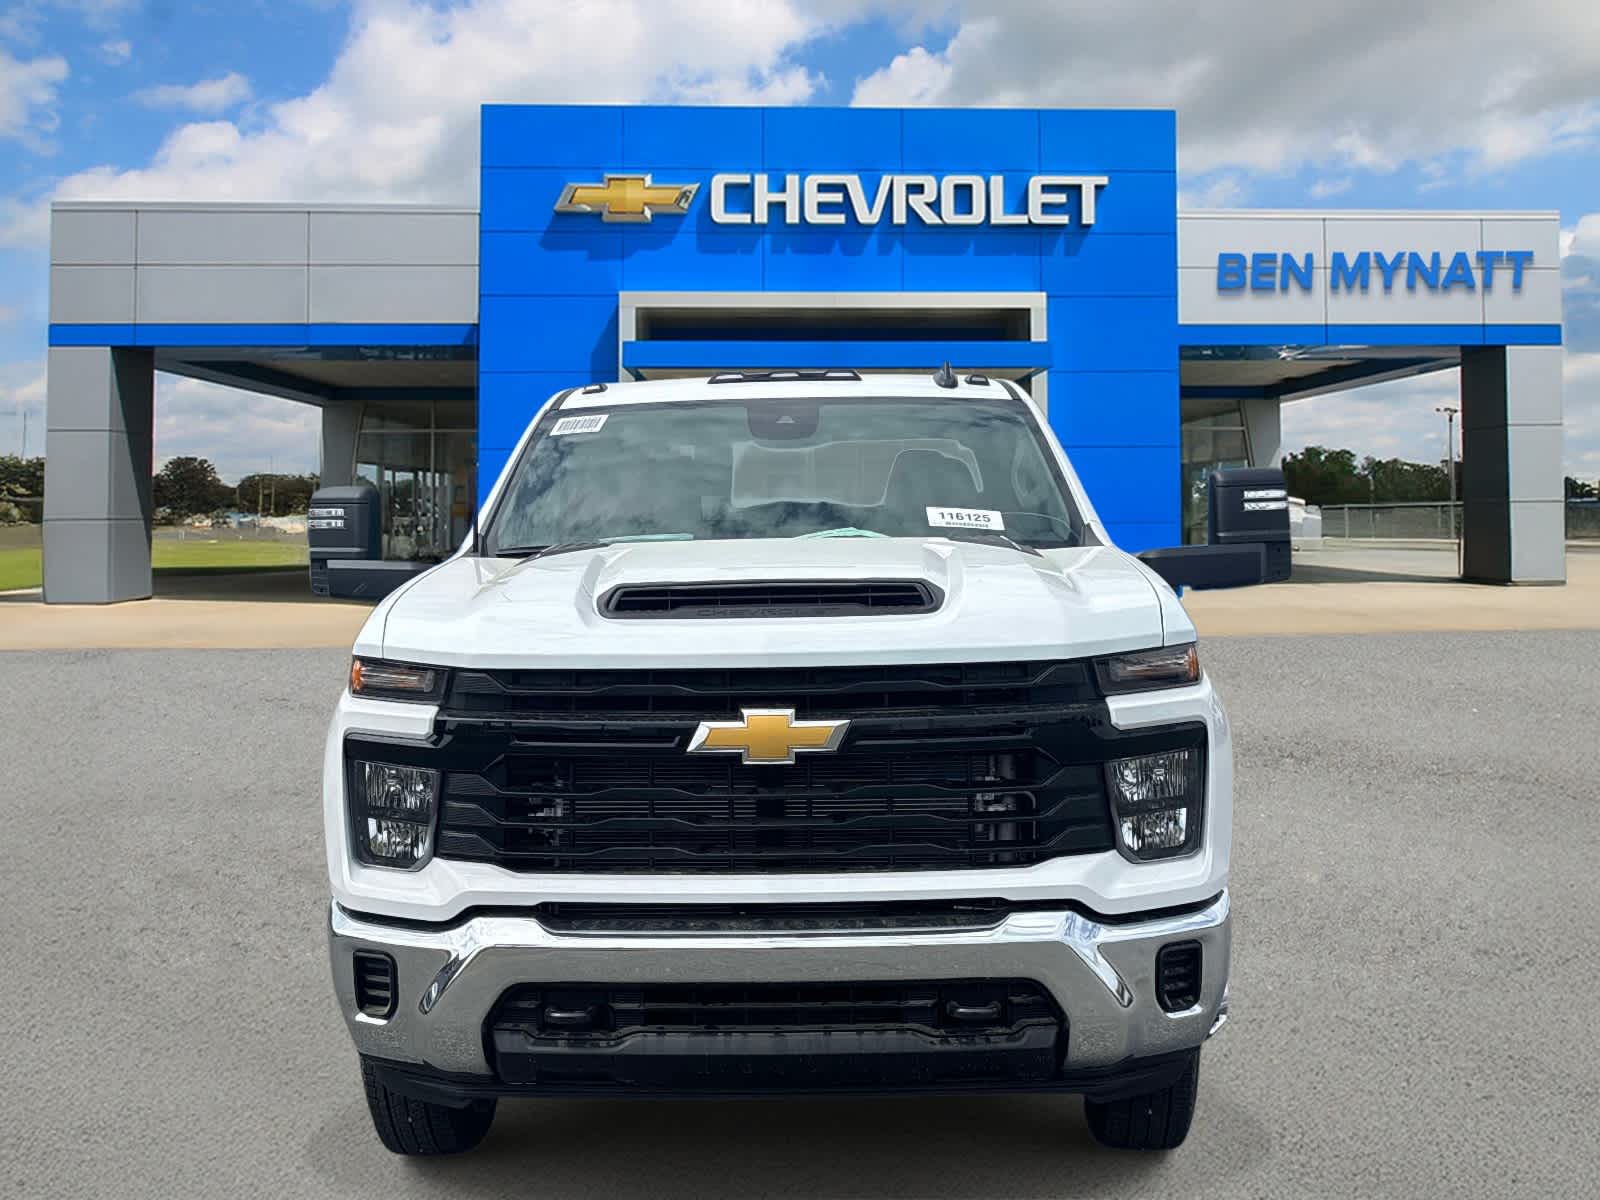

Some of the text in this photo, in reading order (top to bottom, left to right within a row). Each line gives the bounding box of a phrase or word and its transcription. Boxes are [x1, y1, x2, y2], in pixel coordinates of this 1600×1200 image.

[710, 173, 1109, 225] CHEVROLET
[1217, 250, 1534, 290] BEN MYNATT
[938, 511, 991, 523] 116125
